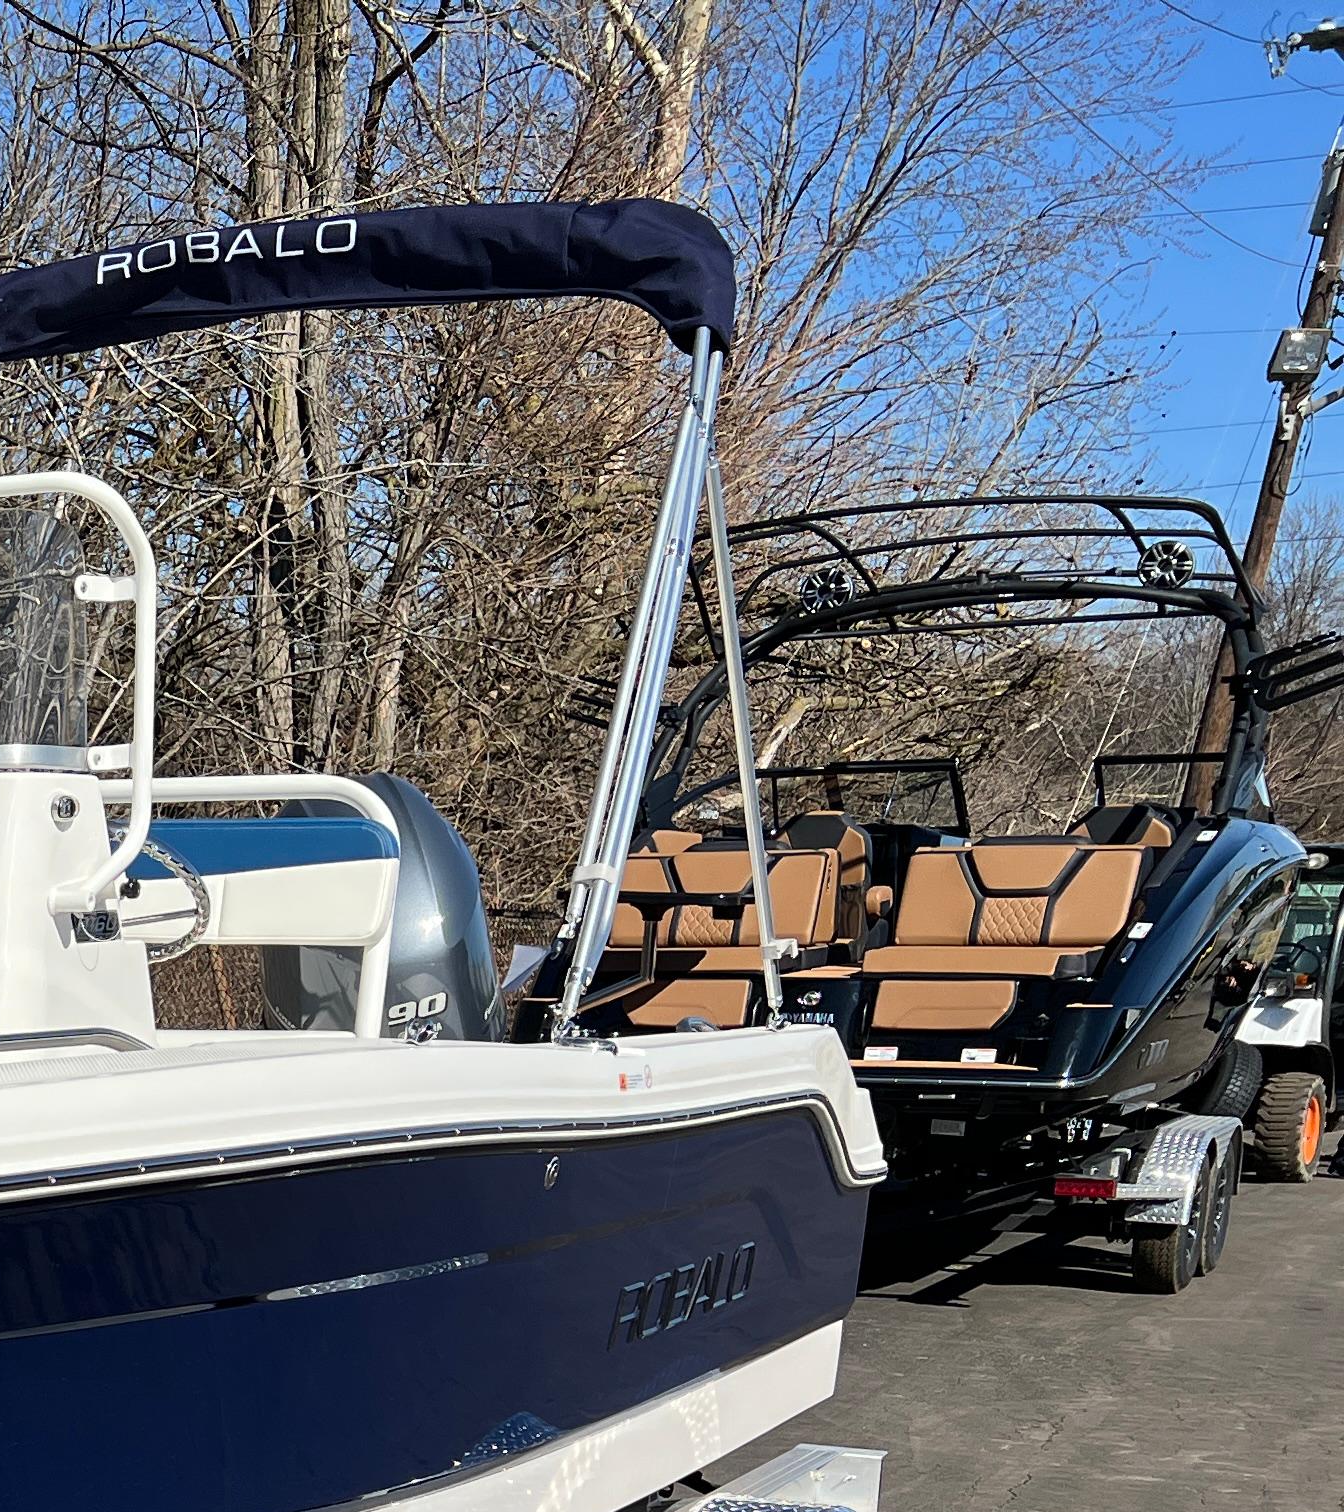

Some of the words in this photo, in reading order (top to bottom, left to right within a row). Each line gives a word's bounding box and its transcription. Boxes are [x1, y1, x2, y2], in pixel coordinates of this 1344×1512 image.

[96, 218, 358, 285] ROBALO
[387, 991, 448, 1027] 90
[792, 1012, 834, 1024] YAMAHA
[607, 1241, 756, 1350] ROBALO
